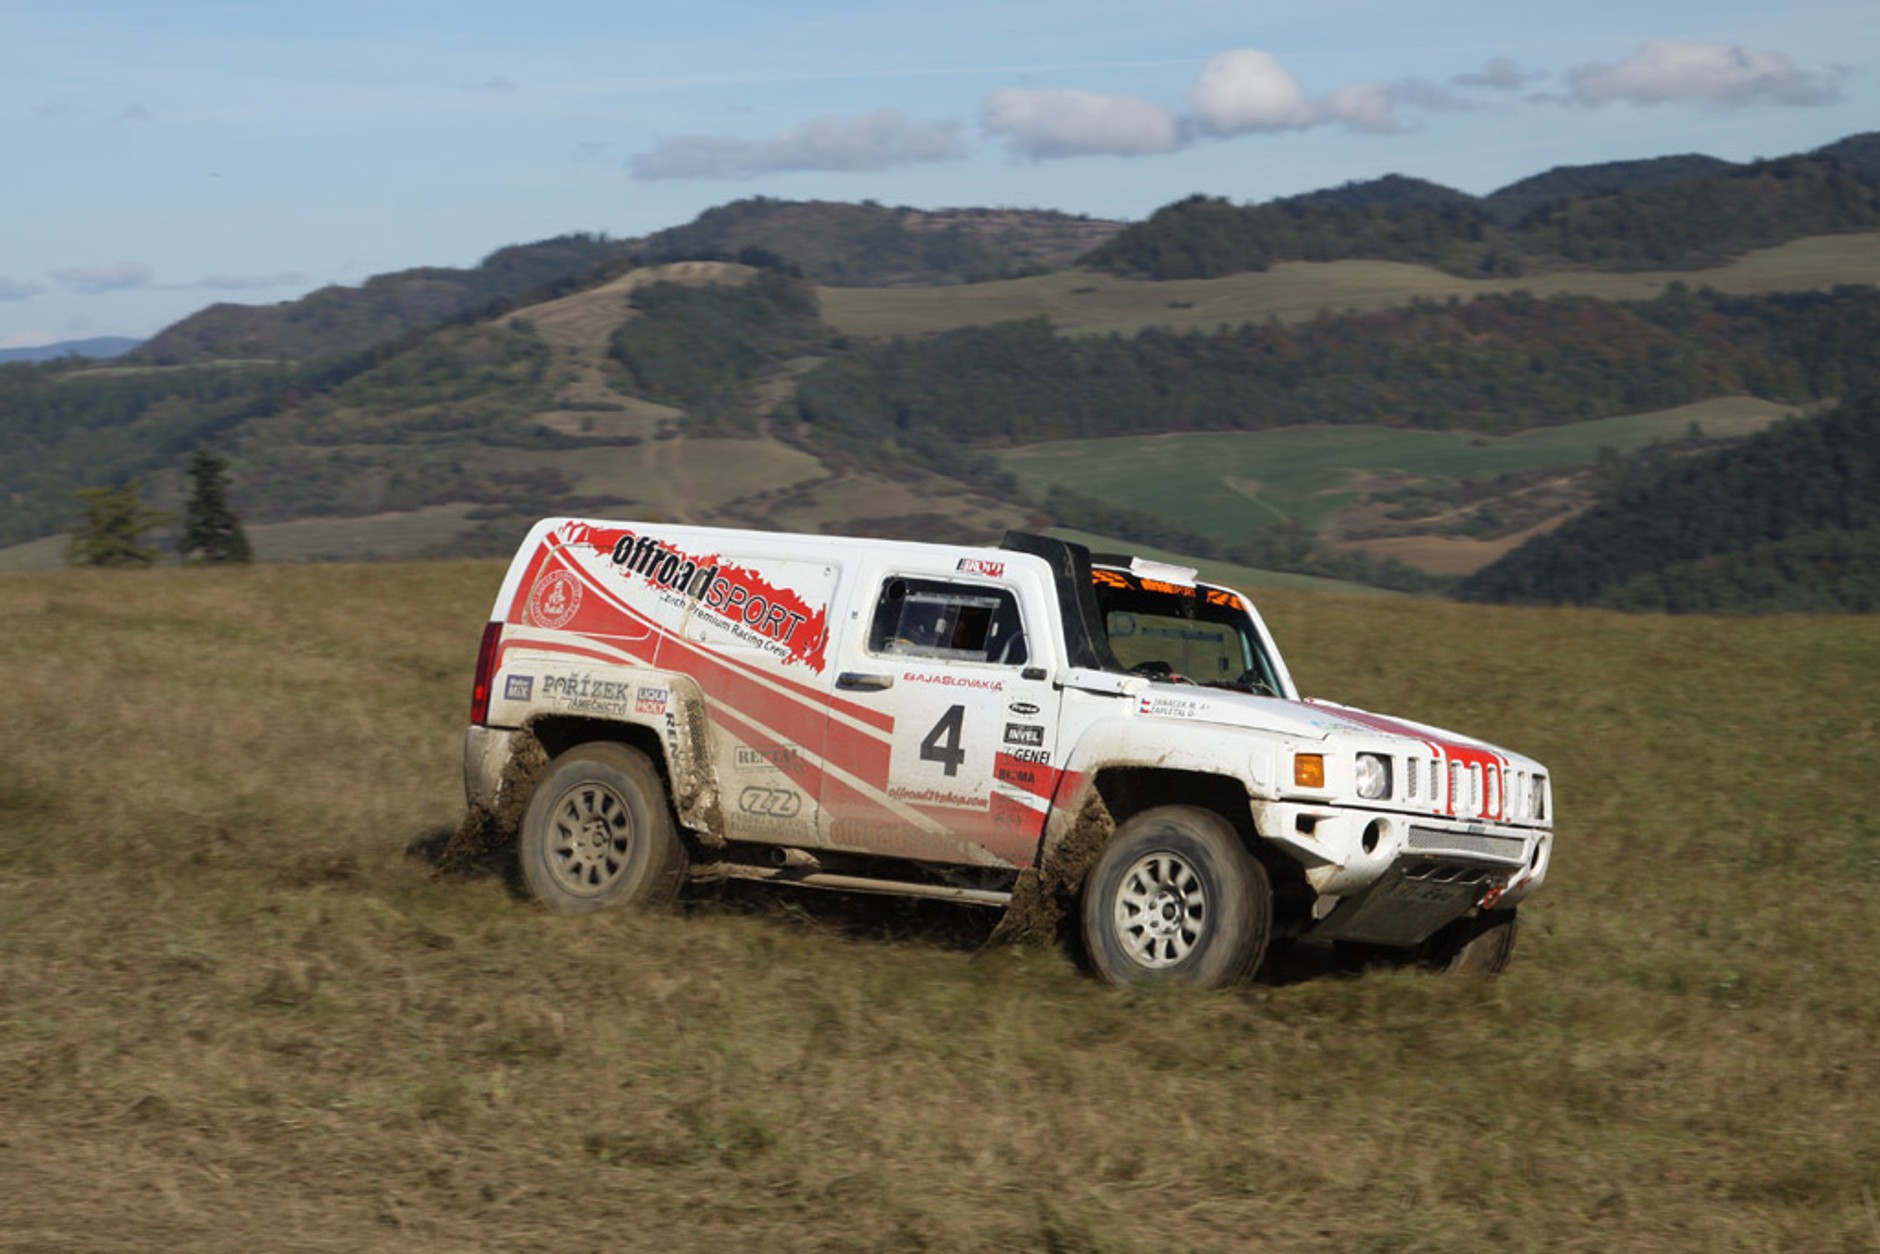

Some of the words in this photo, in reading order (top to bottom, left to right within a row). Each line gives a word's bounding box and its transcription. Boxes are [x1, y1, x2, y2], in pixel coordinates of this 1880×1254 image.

[688, 602, 732, 632] Premium
[730, 624, 763, 649] Racing
[763, 640, 790, 658] Crew
[919, 704, 966, 777] 4
